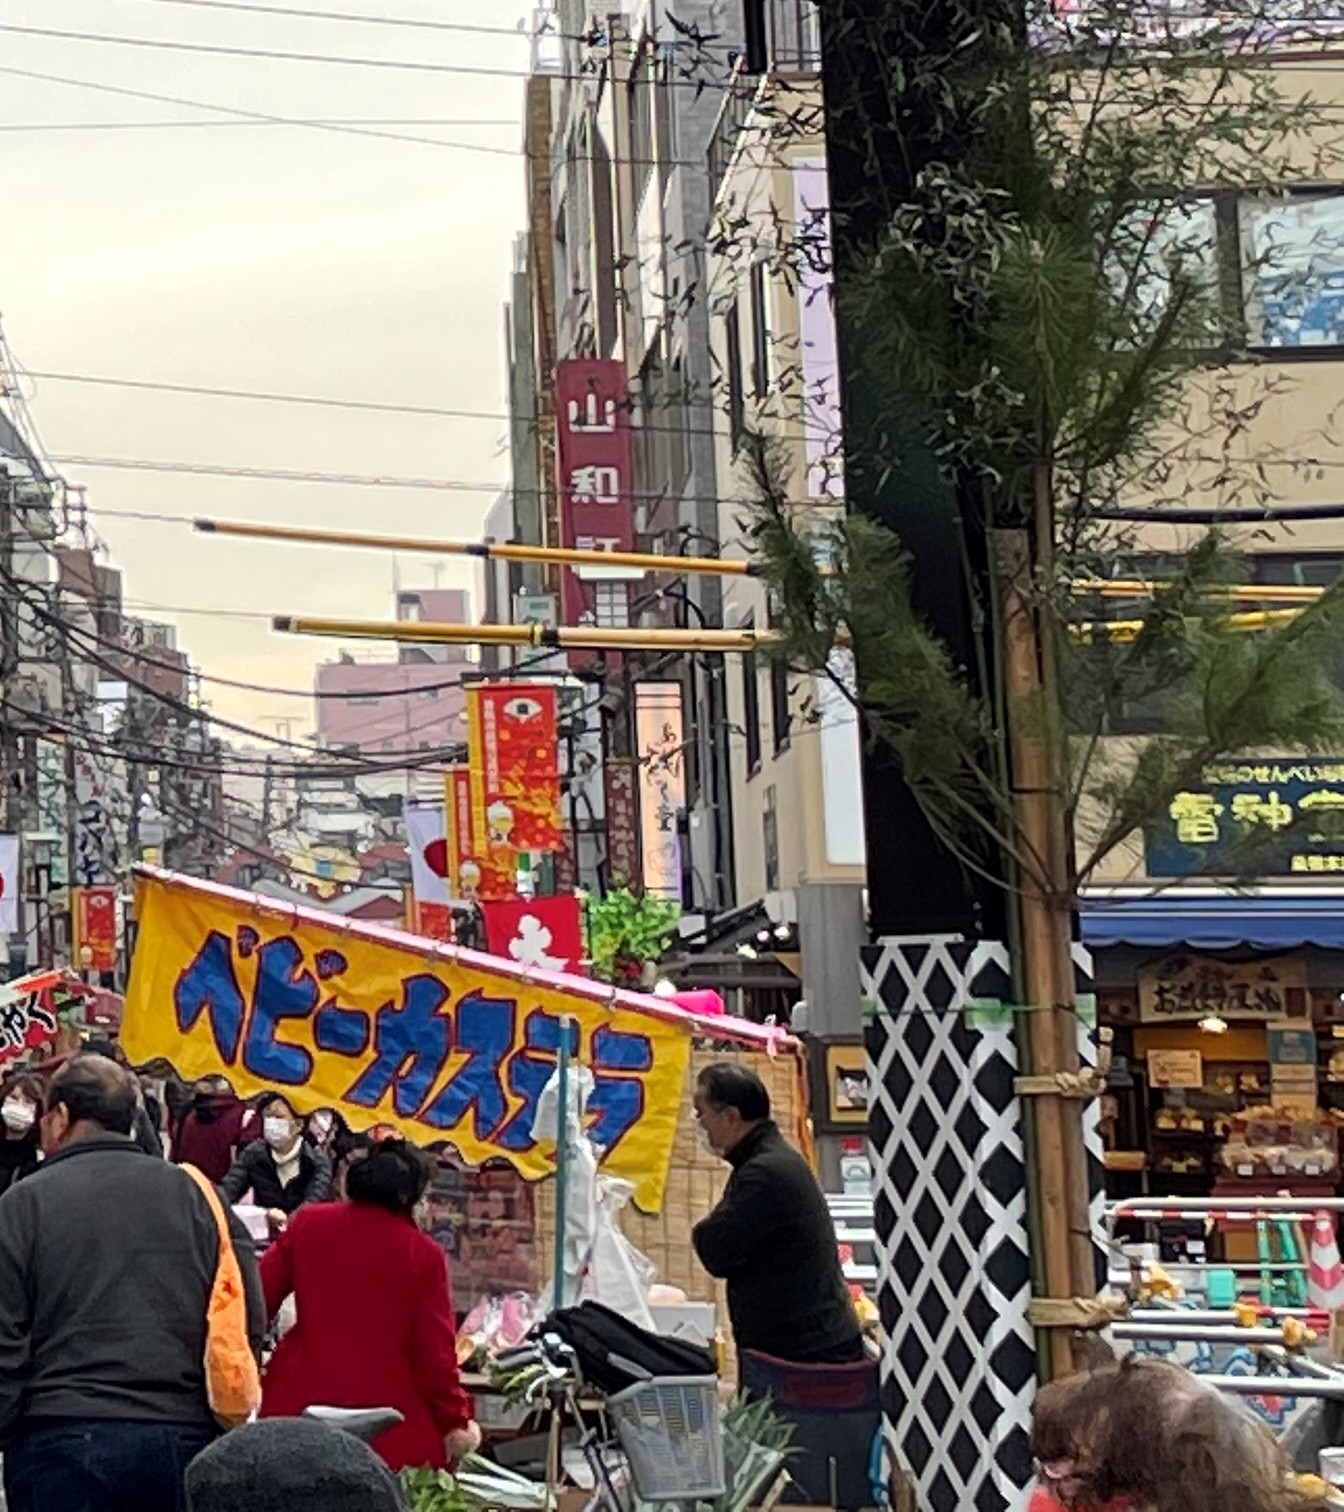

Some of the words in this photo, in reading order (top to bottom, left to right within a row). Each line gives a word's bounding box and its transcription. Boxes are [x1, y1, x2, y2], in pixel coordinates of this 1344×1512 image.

[174, 926, 654, 1166] ベビーカステラ
